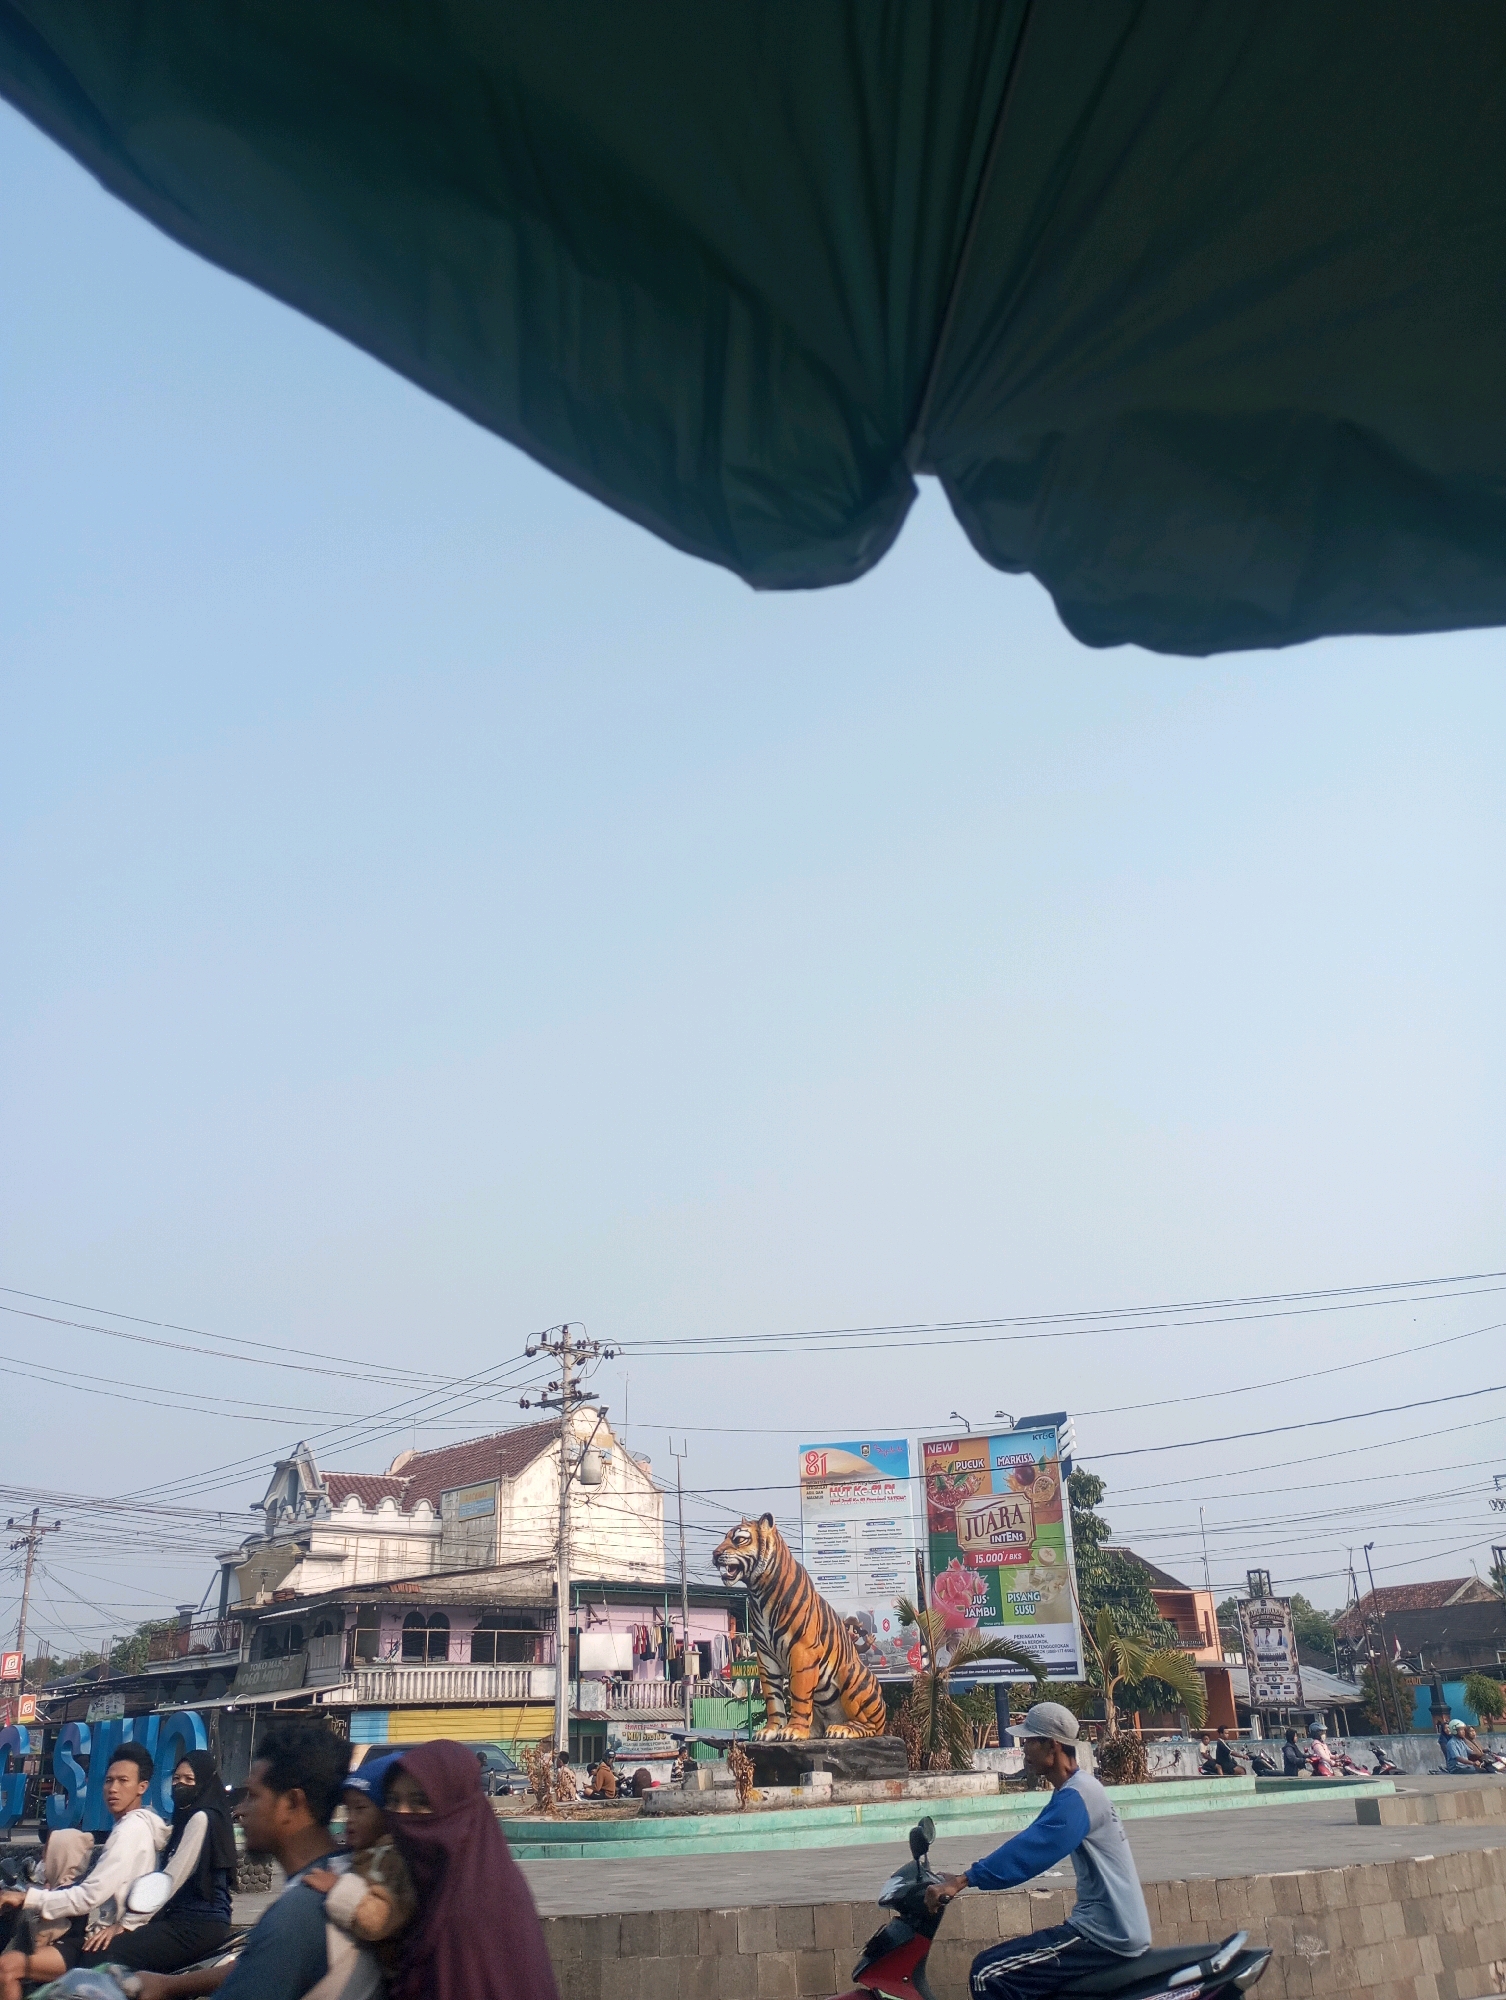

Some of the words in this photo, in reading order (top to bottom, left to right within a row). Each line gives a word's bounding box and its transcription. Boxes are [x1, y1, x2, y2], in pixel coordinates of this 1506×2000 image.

[1032, 1432, 1055, 1441] KT&G
[927, 1442, 954, 1455] NEW
[805, 1450, 829, 1479] 81
[955, 1459, 985, 1471] PUCUK
[997, 1453, 1035, 1467] MARKISA
[830, 1486, 852, 1497] HUT
[884, 1484, 896, 1494] RI
[965, 1503, 1026, 1541] JUARA
[991, 1531, 1024, 1543] INTENS
[1009, 1552, 1022, 1560] BKS
[1007, 1591, 1041, 1603] PISANG
[964, 1606, 997, 1618] JAMBU
[1014, 1604, 1036, 1615] SUSU
[250, 1662, 268, 1672] TOKO
